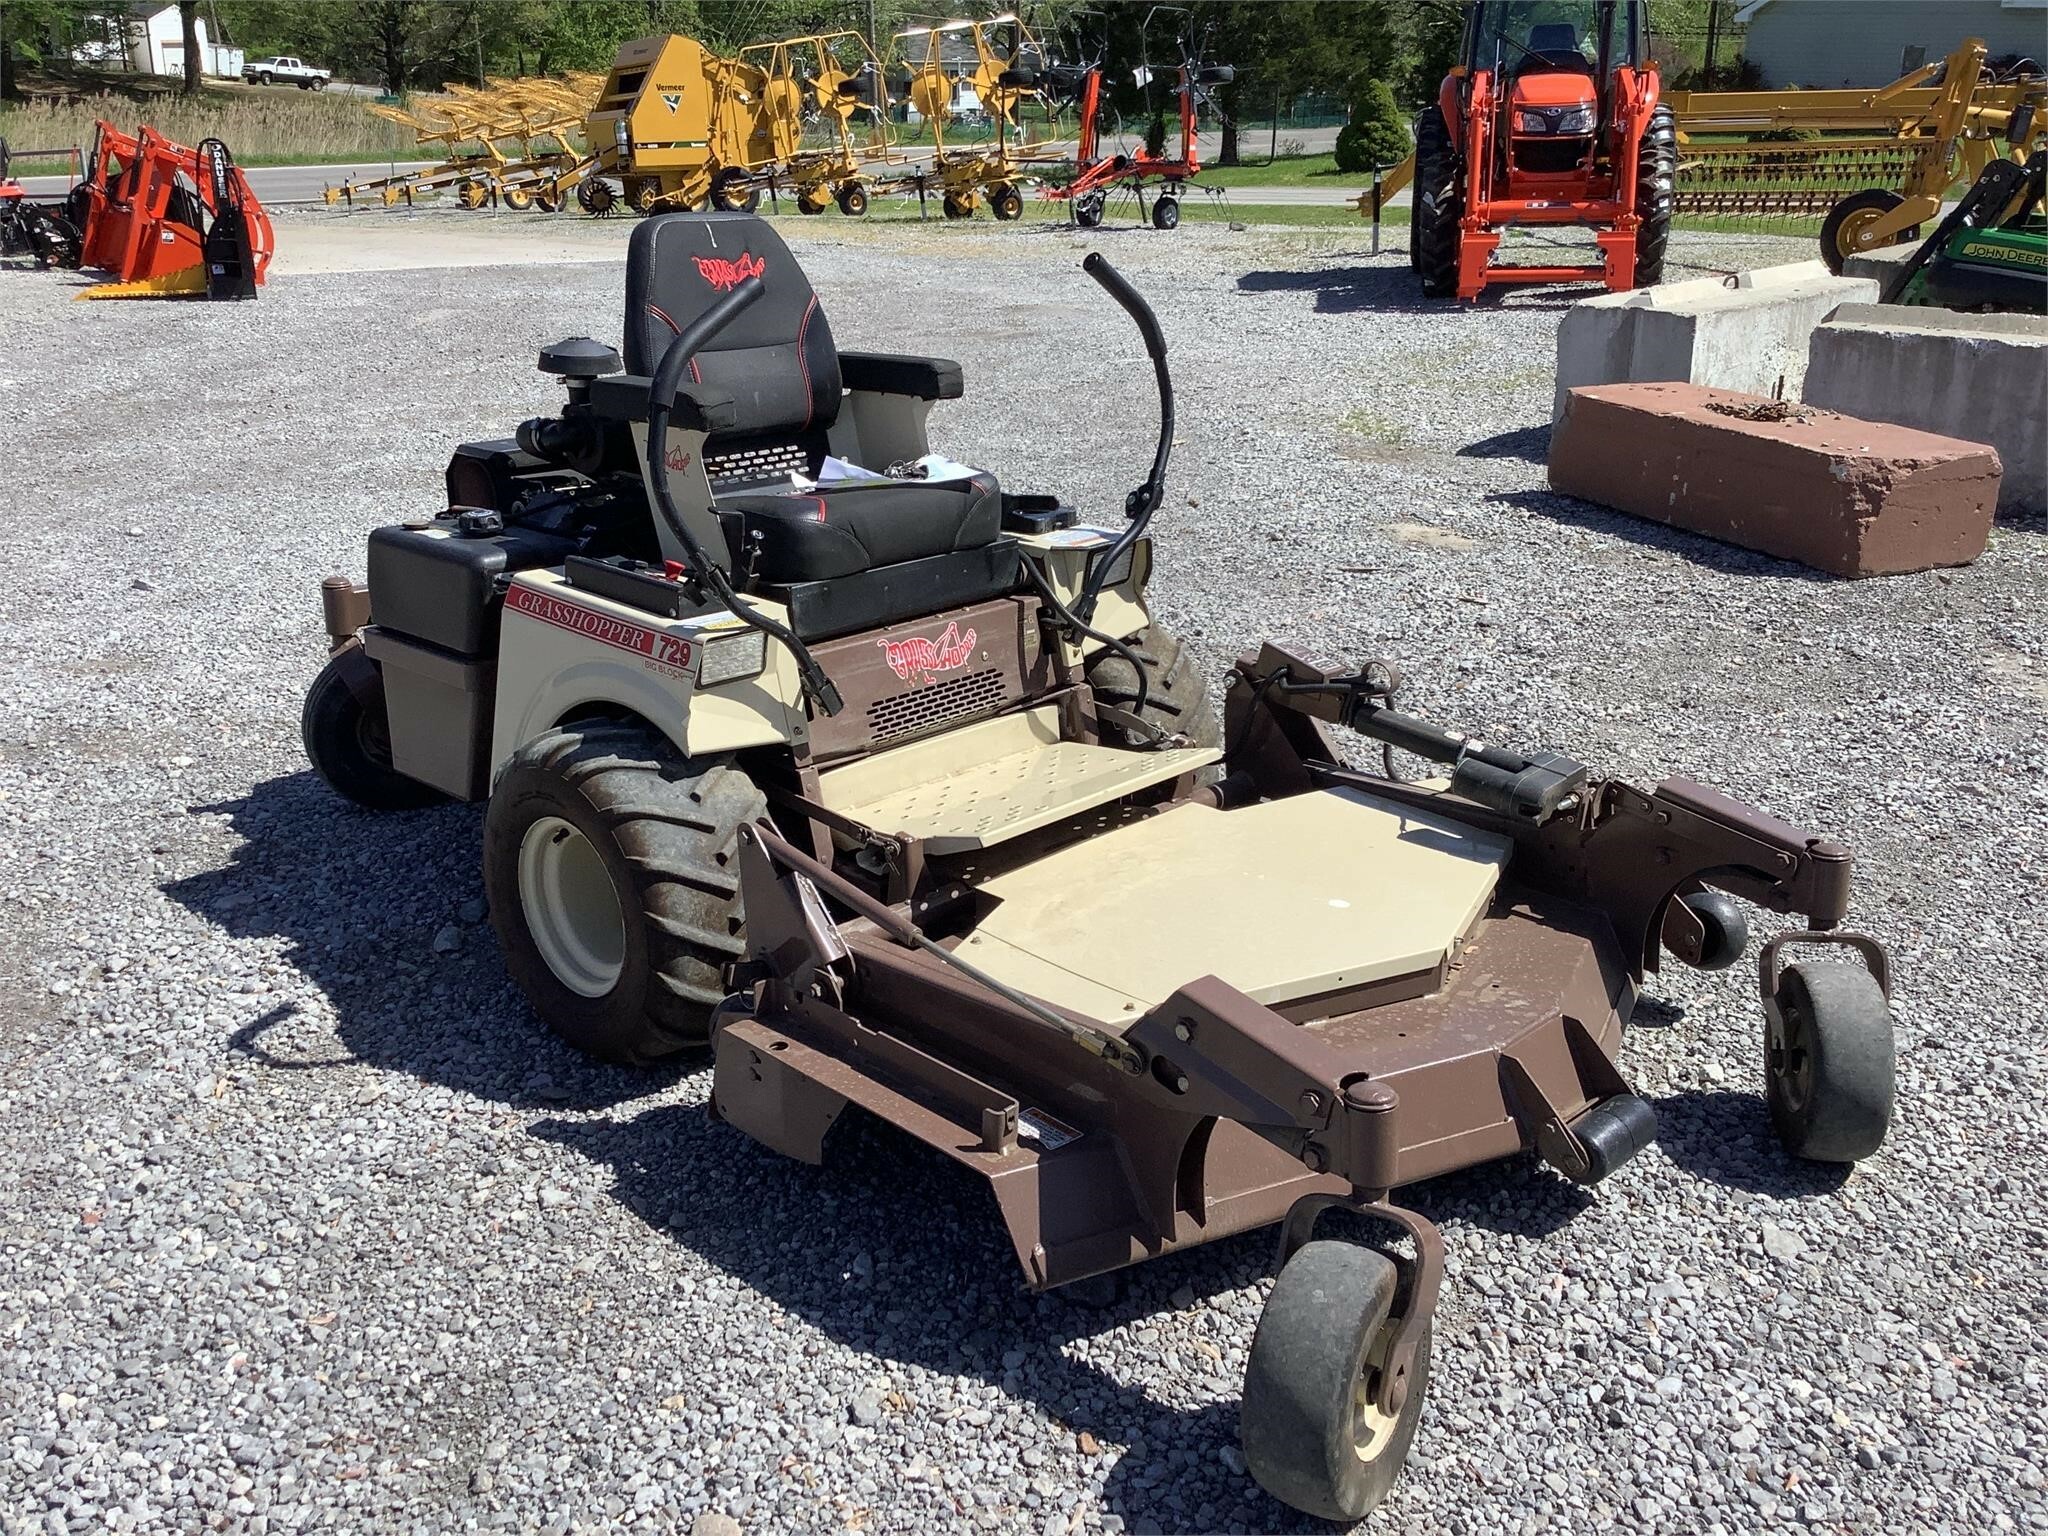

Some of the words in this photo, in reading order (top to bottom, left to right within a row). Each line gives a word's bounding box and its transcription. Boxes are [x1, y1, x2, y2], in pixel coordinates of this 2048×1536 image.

[656, 84, 685, 92] Vermeer
[1969, 245, 2004, 259] JOHN
[518, 591, 645, 650] GRASSHOPPER
[658, 636, 691, 667] 729
[644, 659, 657, 671] BIG
[658, 665, 685, 679] BLOCK
